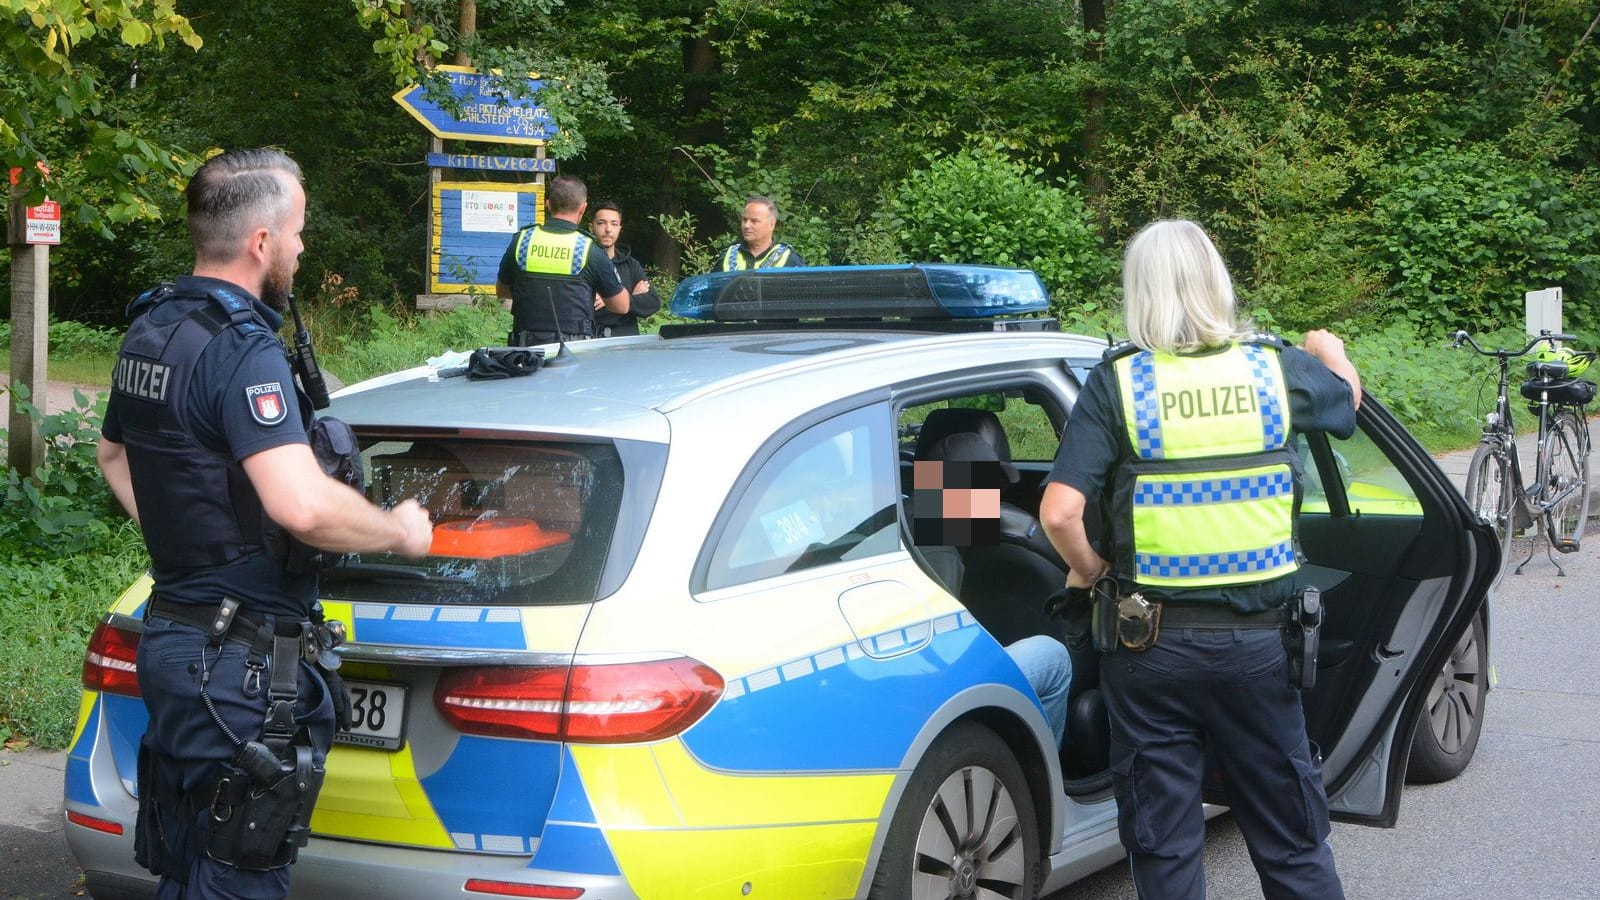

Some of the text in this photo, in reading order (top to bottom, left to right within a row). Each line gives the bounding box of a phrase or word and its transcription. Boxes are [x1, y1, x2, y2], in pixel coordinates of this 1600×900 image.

[530, 244, 571, 260] POLIZEI
[249, 384, 280, 395] POLIZEI
[1161, 384, 1257, 421] POLIZEI
[335, 735, 385, 746] mburg
